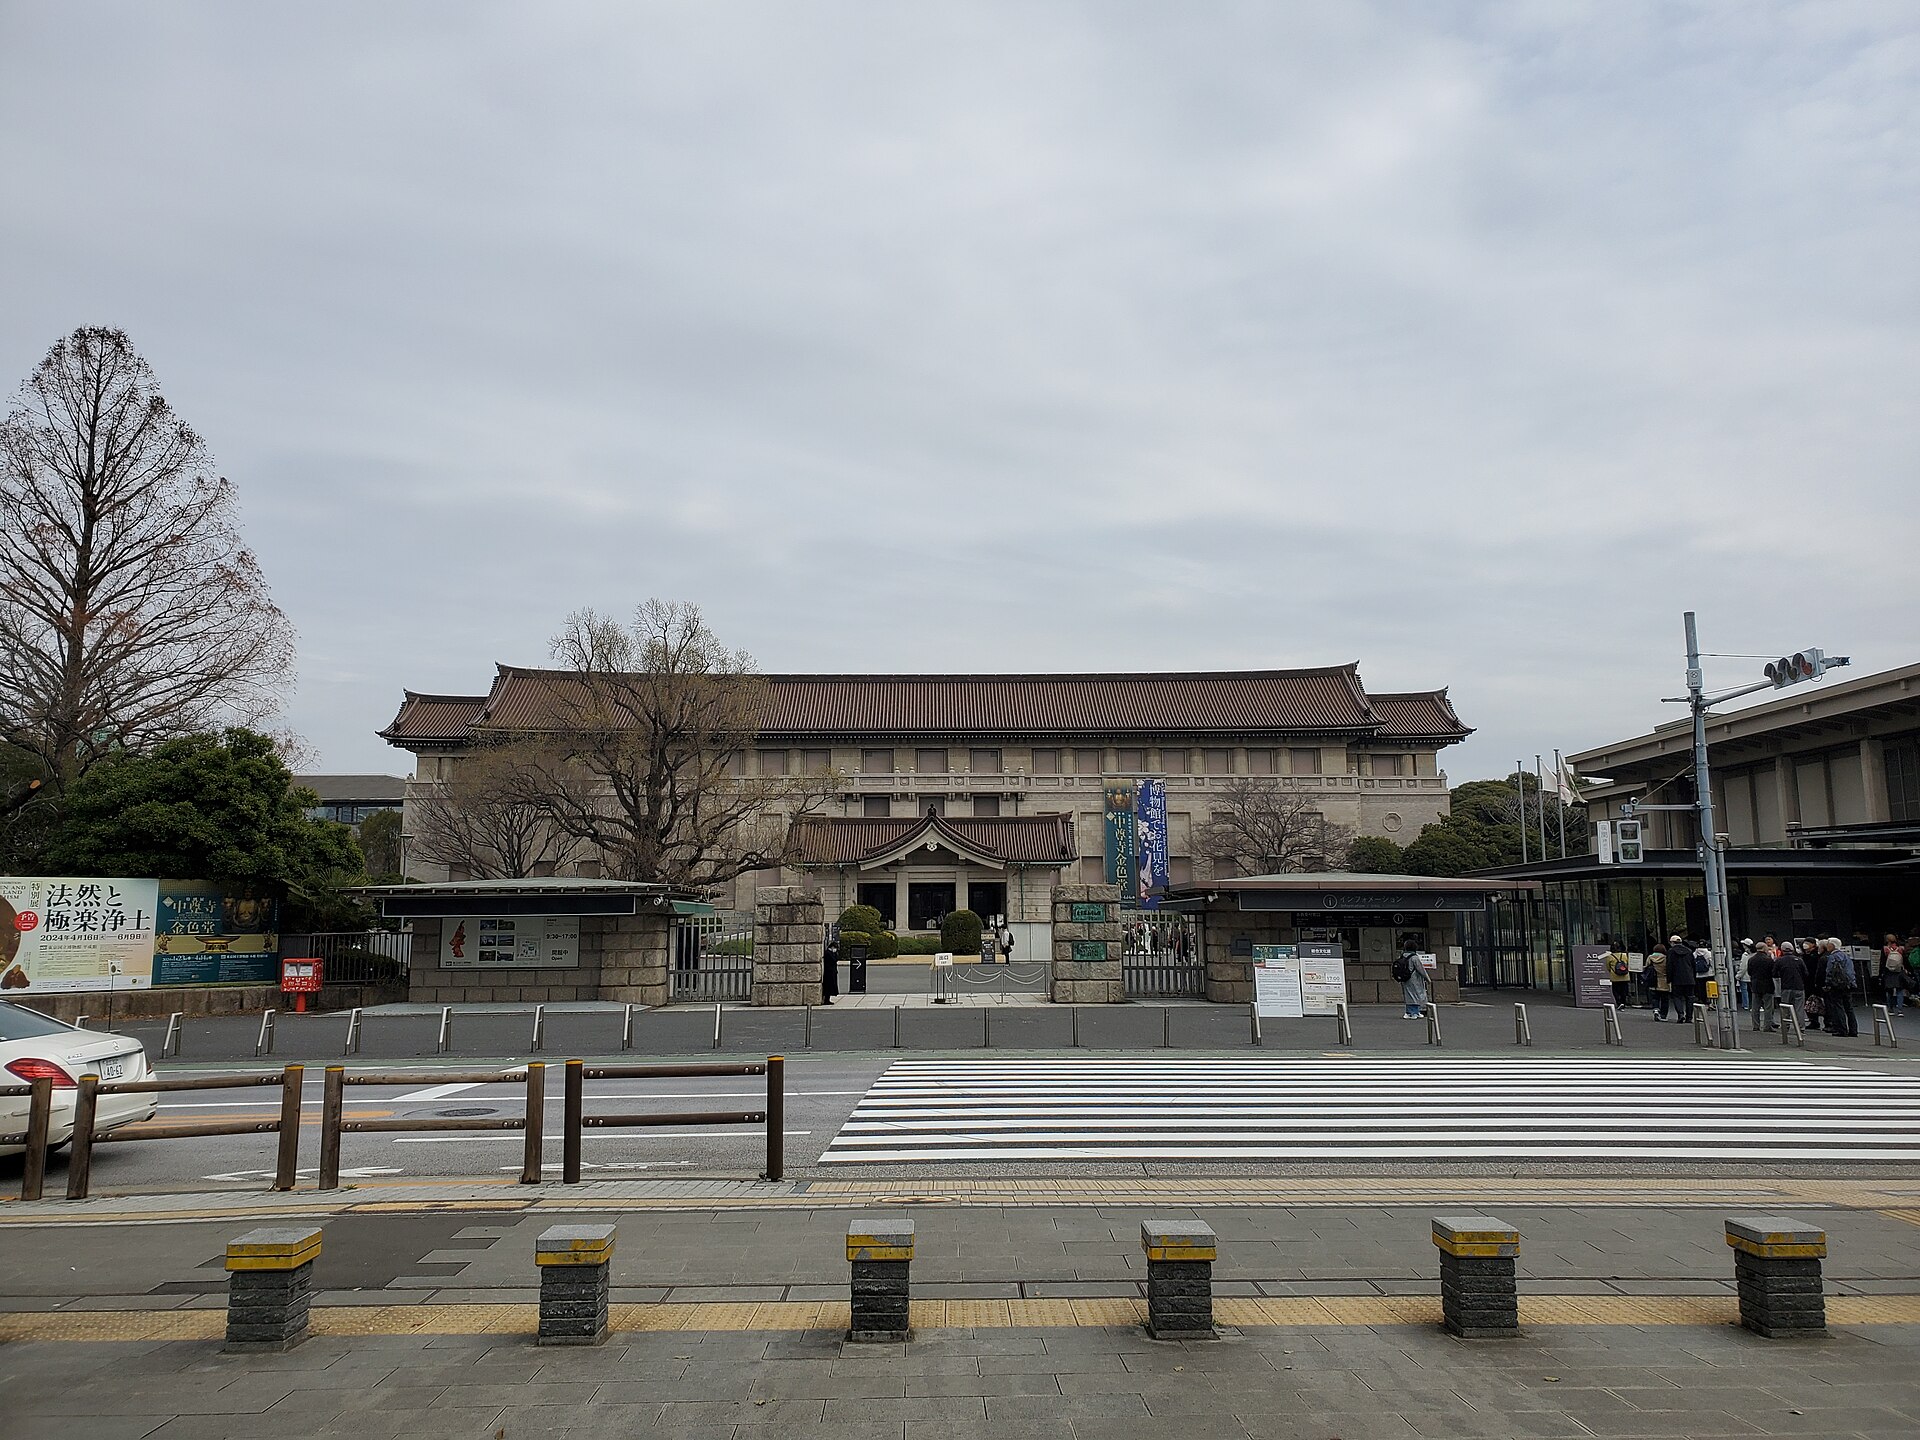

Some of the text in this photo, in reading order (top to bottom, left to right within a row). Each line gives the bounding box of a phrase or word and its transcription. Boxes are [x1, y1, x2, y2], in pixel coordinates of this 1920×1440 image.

[1149, 783, 1164, 877] 博物館でお花見を
[1114, 816, 1128, 891] 中尊寺金色堂
[30, 882, 40, 908] 特別展
[45, 883, 123, 908] 法然と
[172, 899, 217, 914] 中尊寺
[43, 908, 151, 933] 極楽浄土
[171, 921, 216, 934] 金色堂
[106, 1064, 124, 1077] 40-62
